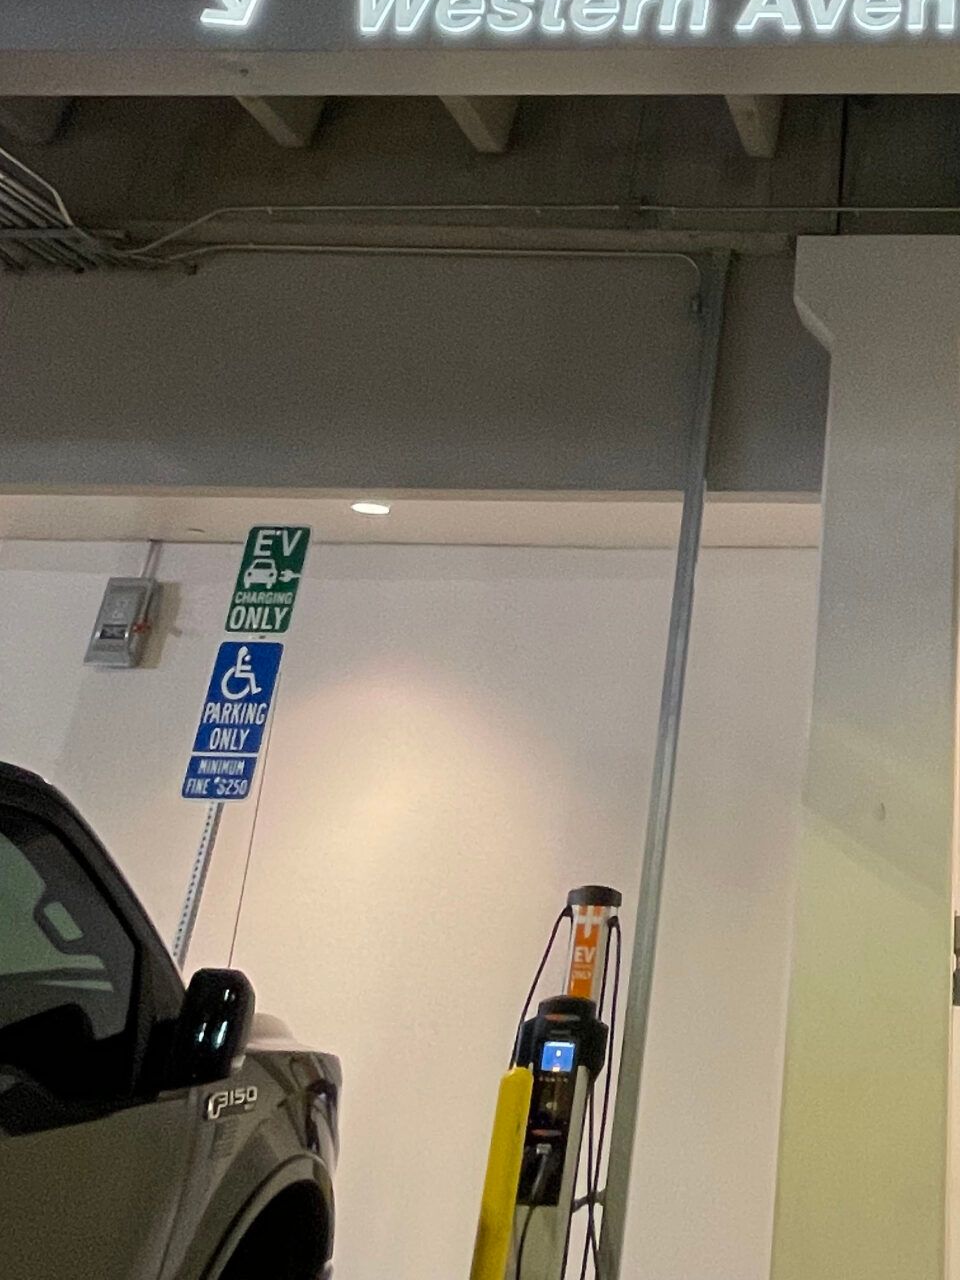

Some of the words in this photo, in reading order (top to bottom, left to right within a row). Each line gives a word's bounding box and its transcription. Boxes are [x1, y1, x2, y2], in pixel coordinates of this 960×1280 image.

[253, 529, 302, 556] EV
[235, 592, 293, 605] CHARGING
[230, 607, 289, 630] ONLY
[203, 702, 267, 724] PARKING
[209, 727, 249, 751] ONLY
[198, 759, 245, 775] MINIMUM
[185, 778, 209, 795] FINE
[575, 946, 597, 962] EV
